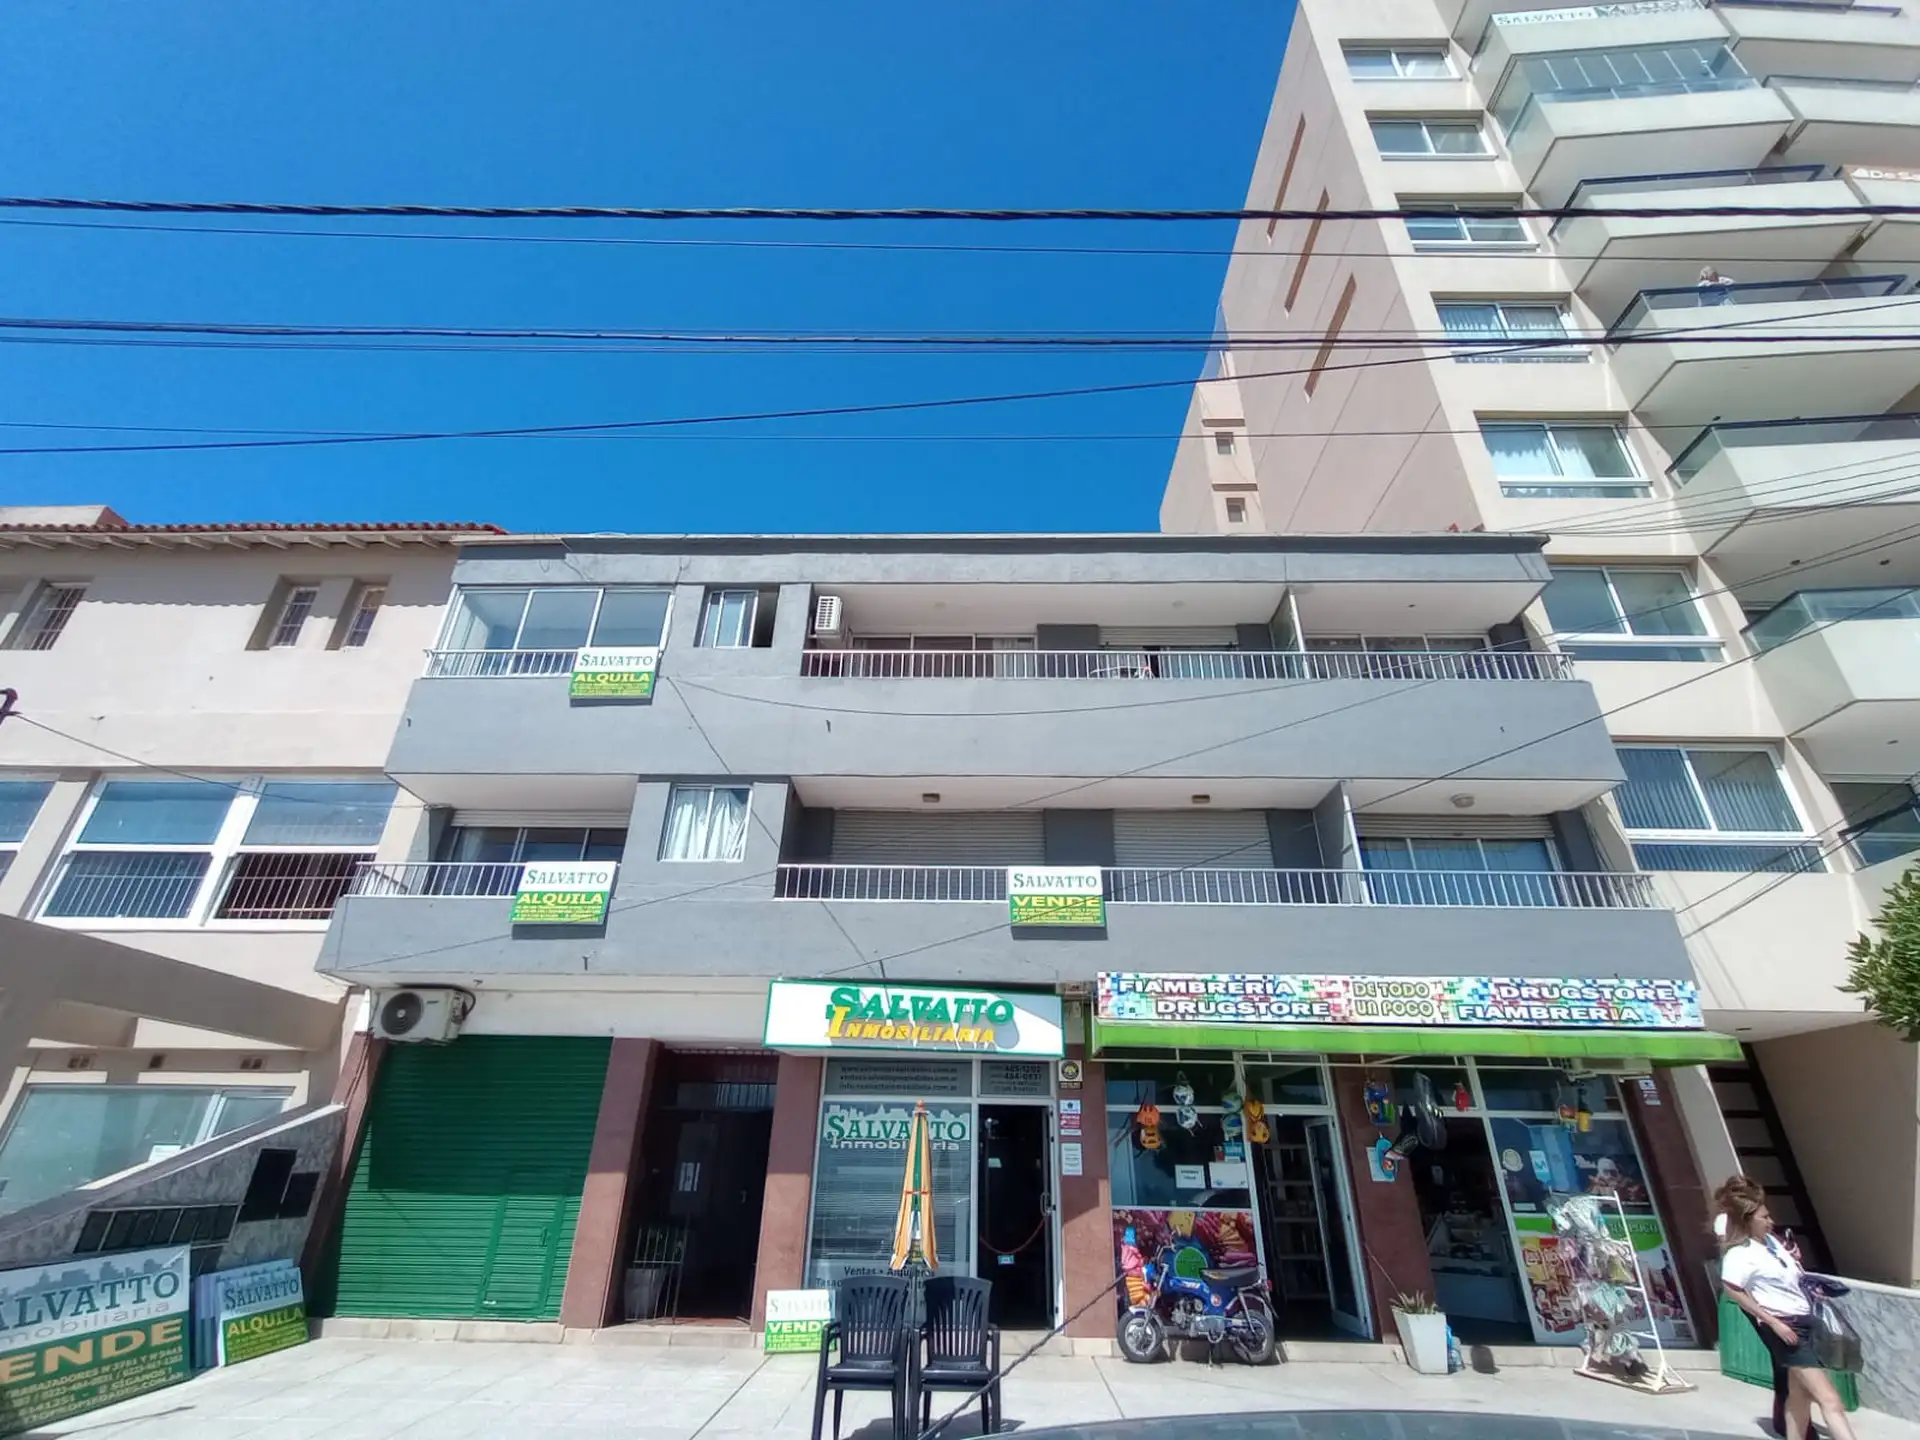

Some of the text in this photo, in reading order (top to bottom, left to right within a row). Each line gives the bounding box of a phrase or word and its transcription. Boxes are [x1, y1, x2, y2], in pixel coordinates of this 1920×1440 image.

[580, 653, 653, 667] SALVATTO
[574, 673, 650, 684] ALQUILA
[525, 868, 608, 885] SALVATTO
[1013, 873, 1098, 889] SALVATTO
[517, 893, 602, 906] ALQUILA
[1012, 895, 1101, 907] VENDE
[1118, 977, 1296, 996] FIAMBRERIA
[1352, 981, 1430, 999] DE TODO
[1498, 984, 1677, 1001] DRUGSTORE
[825, 987, 1015, 1025] SALVATTO
[1156, 999, 1331, 1017] DRUGSTORE
[1380, 999, 1434, 1018] POCO
[1457, 1004, 1643, 1022] FIAMBRERIA
[825, 1005, 995, 1043] INMOBILIARIA
[826, 1114, 967, 1141] SALVATO
[224, 1278, 299, 1311] SALVATTO
[228, 1307, 304, 1338] ALQUILA
